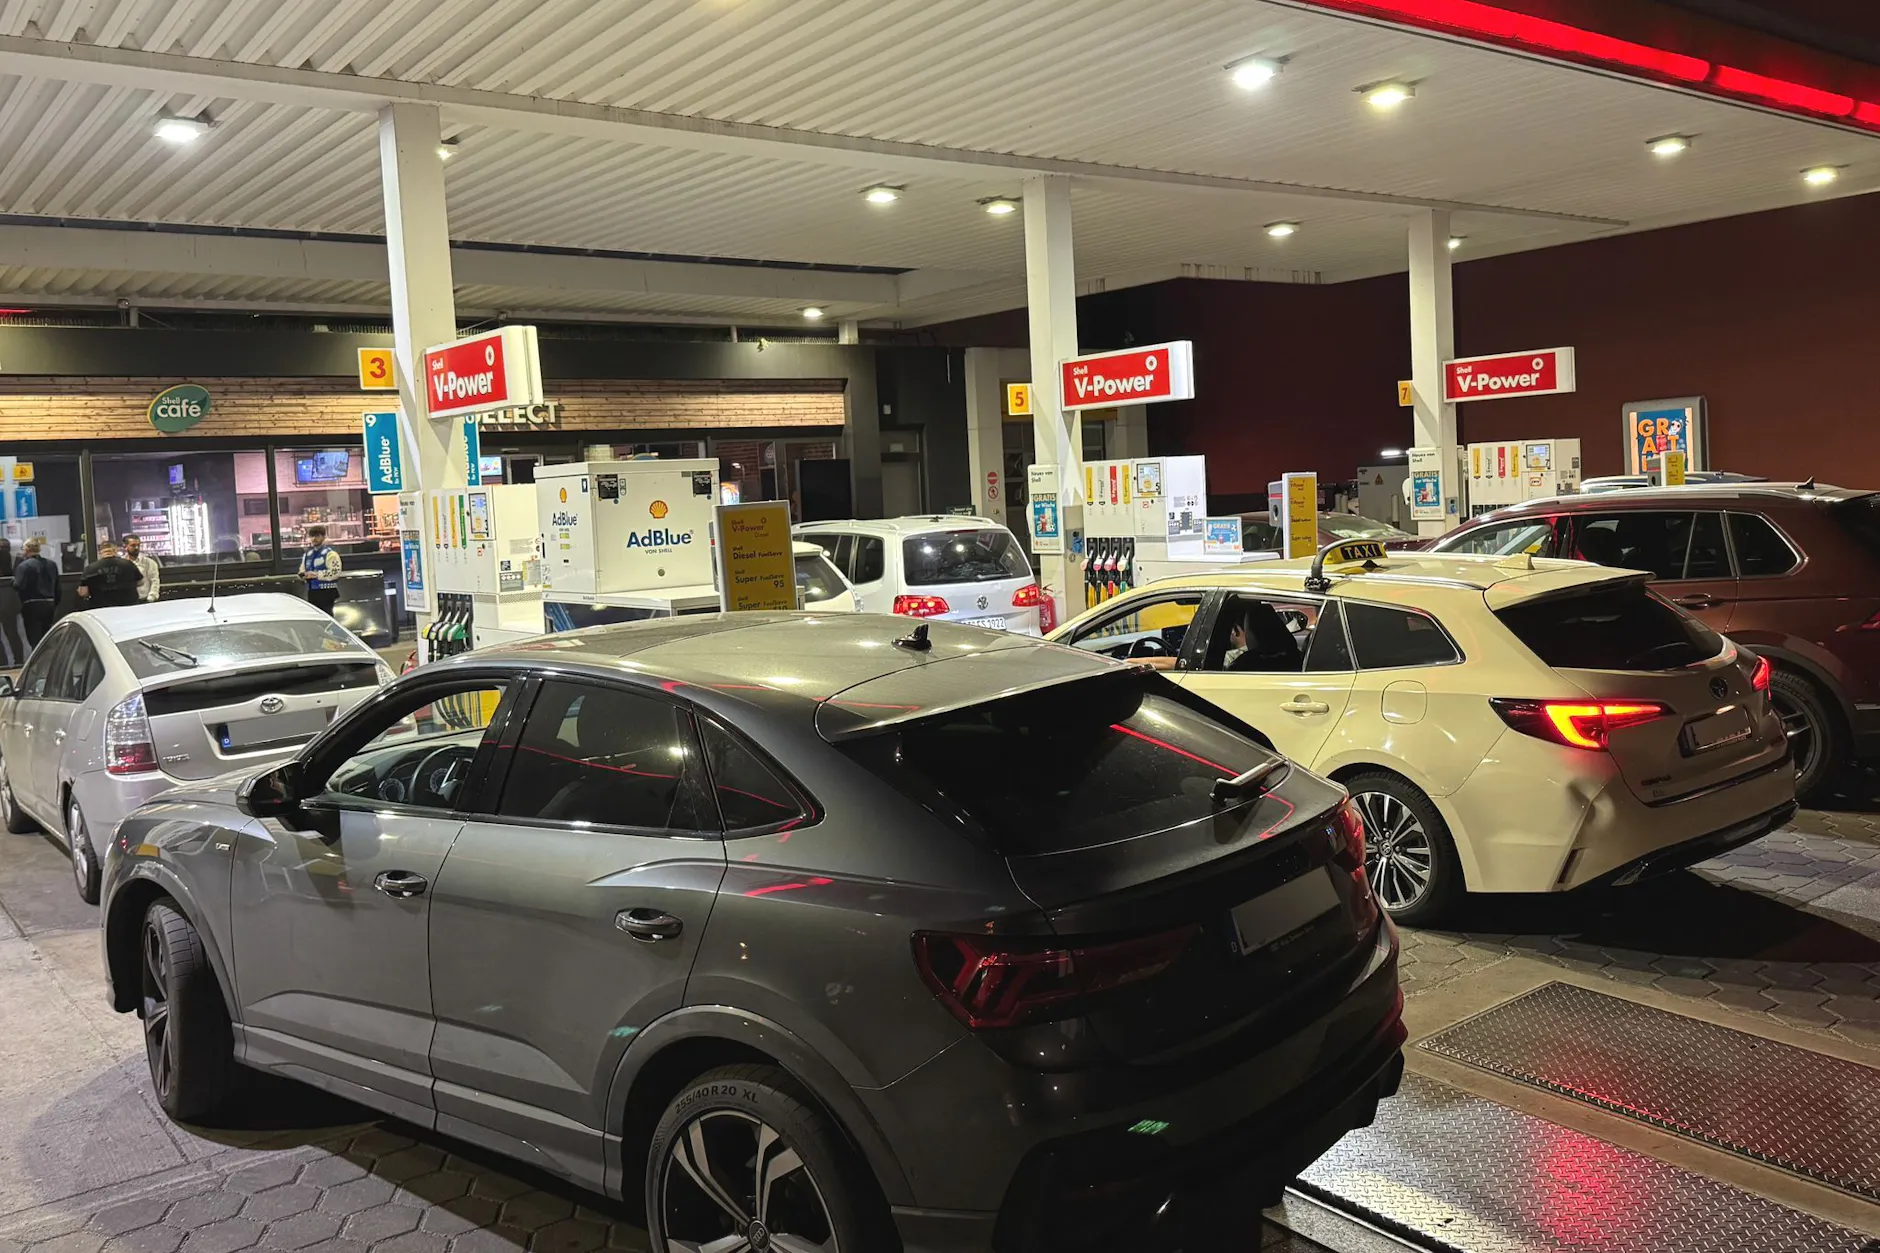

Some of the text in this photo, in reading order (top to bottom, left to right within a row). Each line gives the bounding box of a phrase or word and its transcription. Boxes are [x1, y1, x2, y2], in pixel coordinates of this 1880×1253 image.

[370, 358, 386, 378] 3
[432, 358, 444, 370] Shell
[1073, 365, 1088, 376] Shell
[1456, 365, 1472, 374] Shell
[433, 371, 494, 402] V-Power
[1073, 374, 1154, 399] V-Power
[1457, 372, 1540, 393] V-Power
[1014, 392, 1025, 407] 5
[1402, 388, 1408, 400] 7
[157, 399, 201, 418] café
[475, 401, 559, 424] ELECT
[366, 415, 376, 427] 9
[378, 438, 394, 485] AdBlue
[1033, 494, 1056, 502] GRATIS
[552, 511, 577, 526] AdBlue
[626, 529, 692, 548] AdBlue
[733, 550, 756, 560] Diesel
[1344, 544, 1378, 559] TAXI
[735, 576, 758, 584] Super
[774, 580, 784, 588] 95
[738, 602, 760, 610] Super
[675, 1087, 710, 1114] 255/40
[742, 1089, 759, 1103] XL
